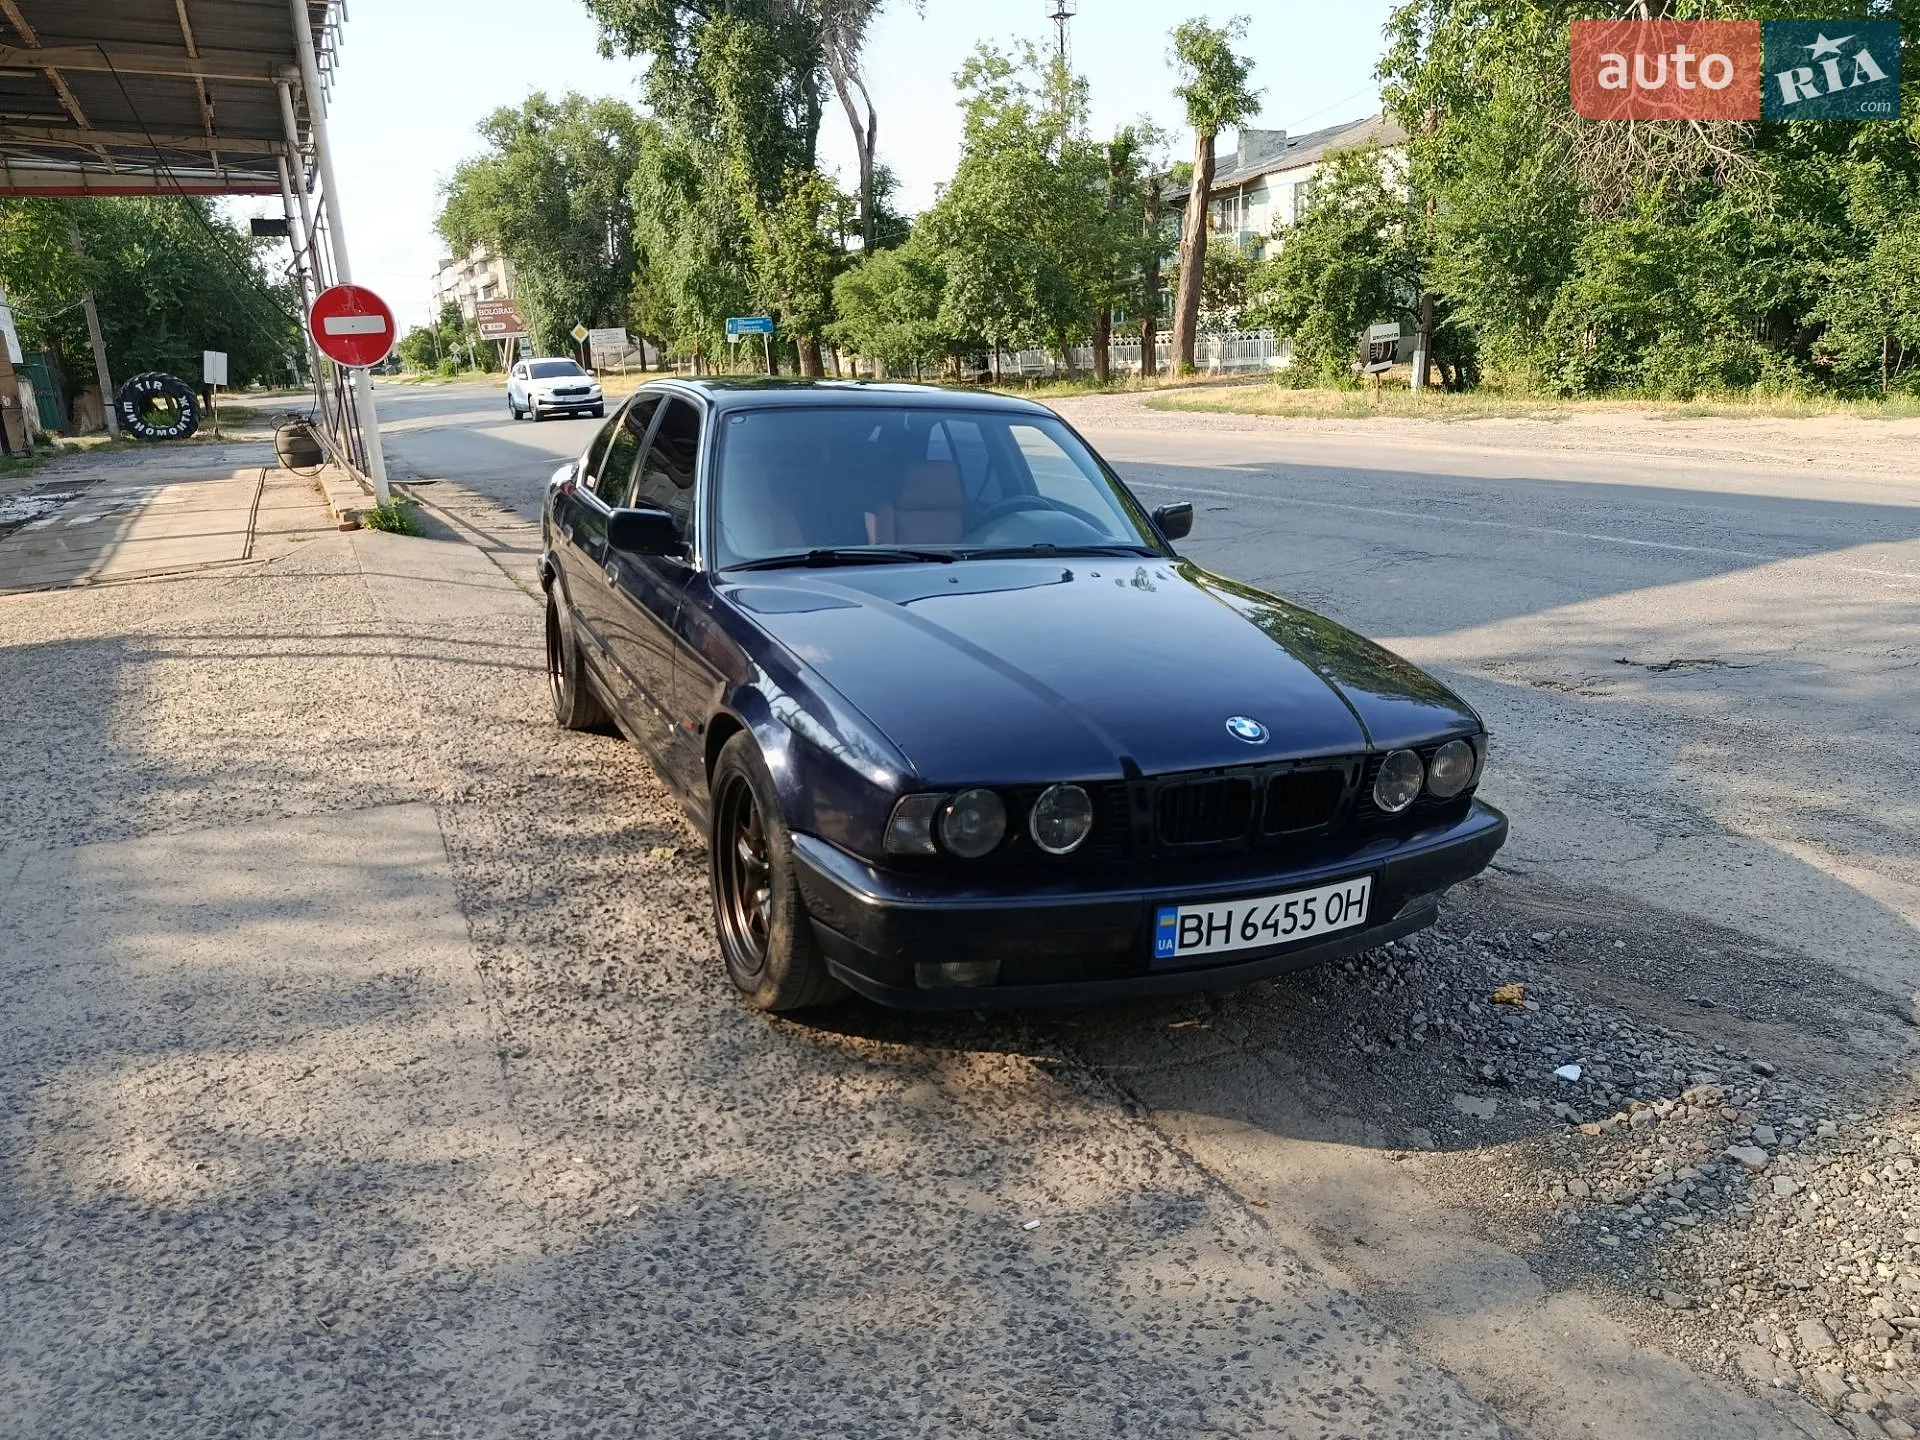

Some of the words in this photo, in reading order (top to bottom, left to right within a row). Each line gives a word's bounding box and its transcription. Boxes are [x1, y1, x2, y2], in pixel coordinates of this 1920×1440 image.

[135, 380, 163, 392] TIR
[123, 395, 191, 436] ШИНОМОНТАЖ
[1178, 910, 1233, 949] BH
[1240, 896, 1317, 942] 6455
[1324, 885, 1366, 926] OH
[1158, 938, 1173, 950] UA
